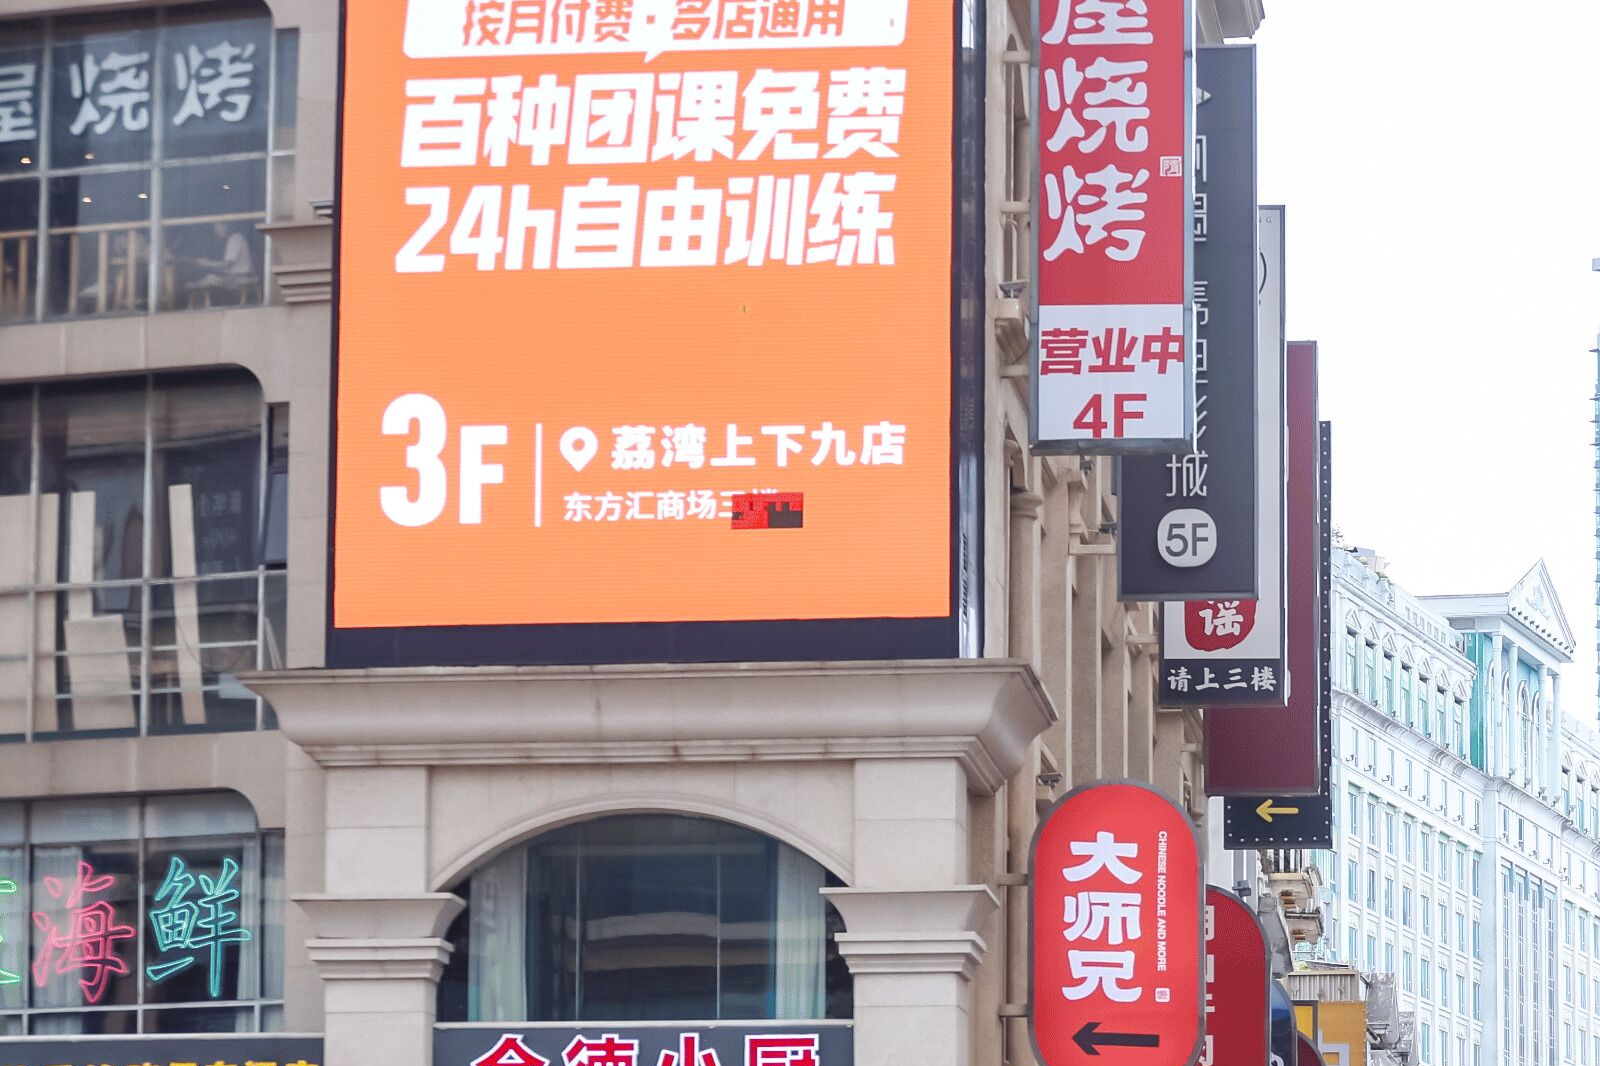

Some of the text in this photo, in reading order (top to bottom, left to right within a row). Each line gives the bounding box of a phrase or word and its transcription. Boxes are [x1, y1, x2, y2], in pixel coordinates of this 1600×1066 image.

[400, 67, 908, 167] 百种团课免费
[395, 171, 898, 273] 24h自由训练
[1040, 326, 1184, 375] 营业中
[380, 392, 508, 527] 3F
[611, 421, 906, 470] 荔湾上下九店
[1073, 393, 1147, 439] 4F
[1165, 522, 1209, 558] 5F
[1167, 666, 1277, 693] 请上三楼
[0, 856, 251, 1004] 海鲜
[1062, 831, 1143, 1003] 大师兄
[1156, 830, 1168, 972] CHINESE NOODLE AND MORE
